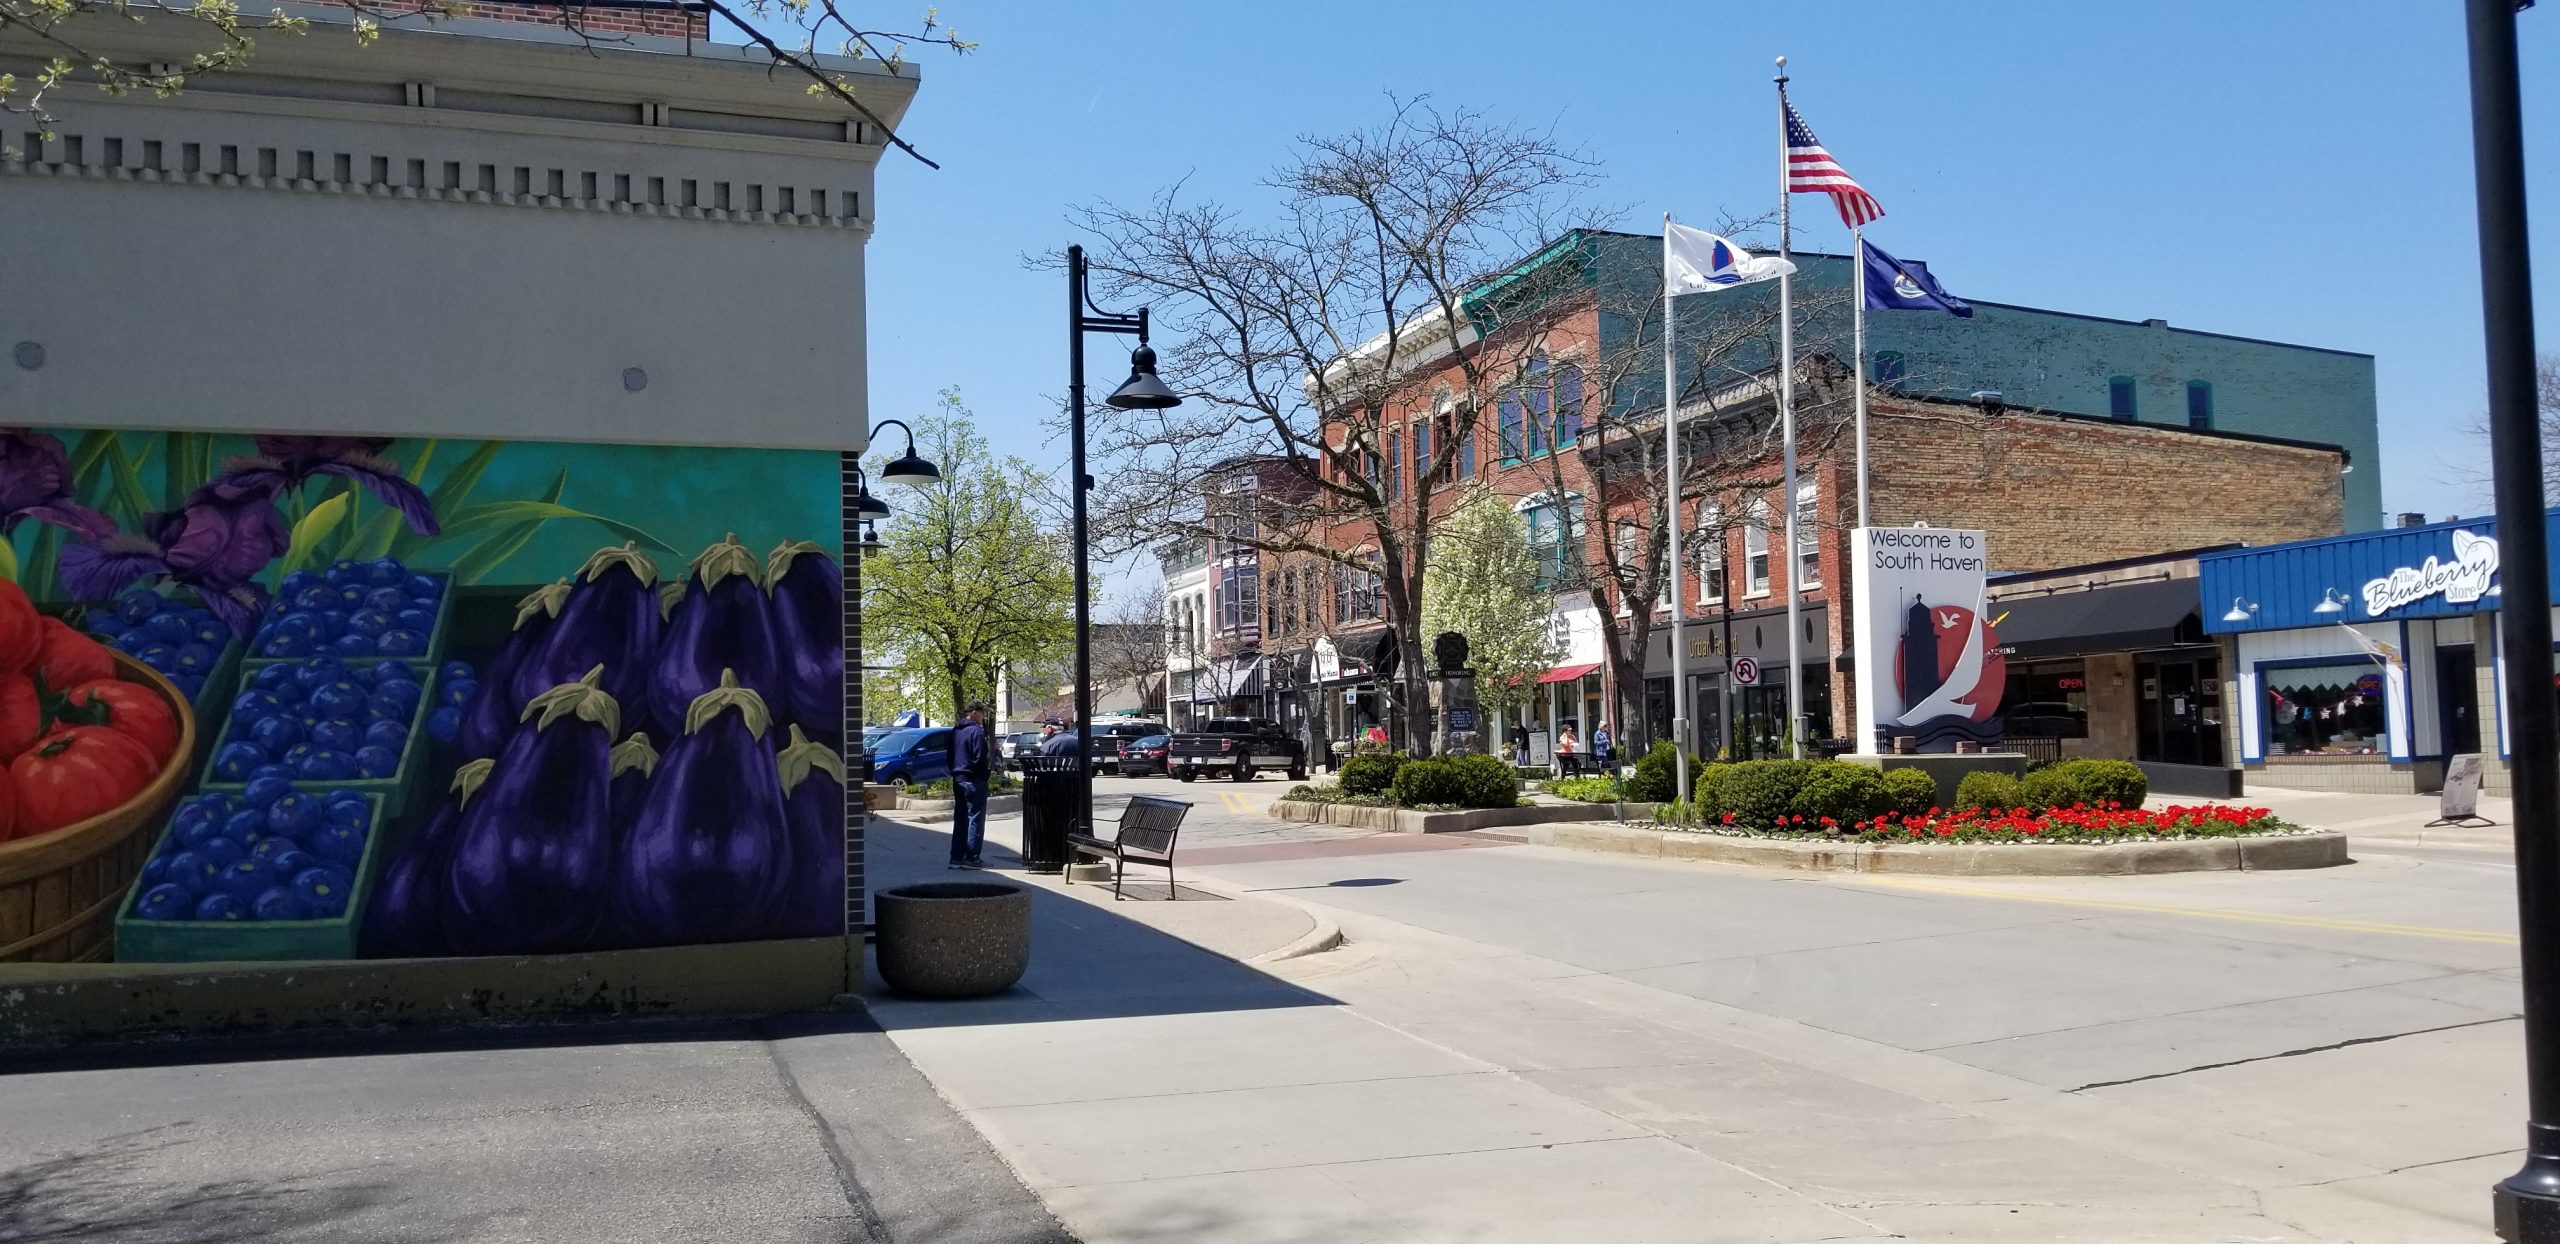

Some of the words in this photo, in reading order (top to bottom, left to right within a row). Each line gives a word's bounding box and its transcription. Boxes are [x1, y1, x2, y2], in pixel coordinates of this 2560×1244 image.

[1869, 529, 1951, 549] Welcome
[1958, 531, 1975, 549] to
[1875, 550, 1924, 570] South
[1930, 552, 1983, 571] Haven
[2367, 559, 2487, 611] Blueberry
[2397, 570, 2416, 583] The
[2448, 583, 2478, 600] Store
[1688, 637, 1710, 659] Urban
[1714, 632, 1739, 657] Fod
[1987, 646, 2016, 655] ATERING
[2058, 678, 2084, 689] OPEN
